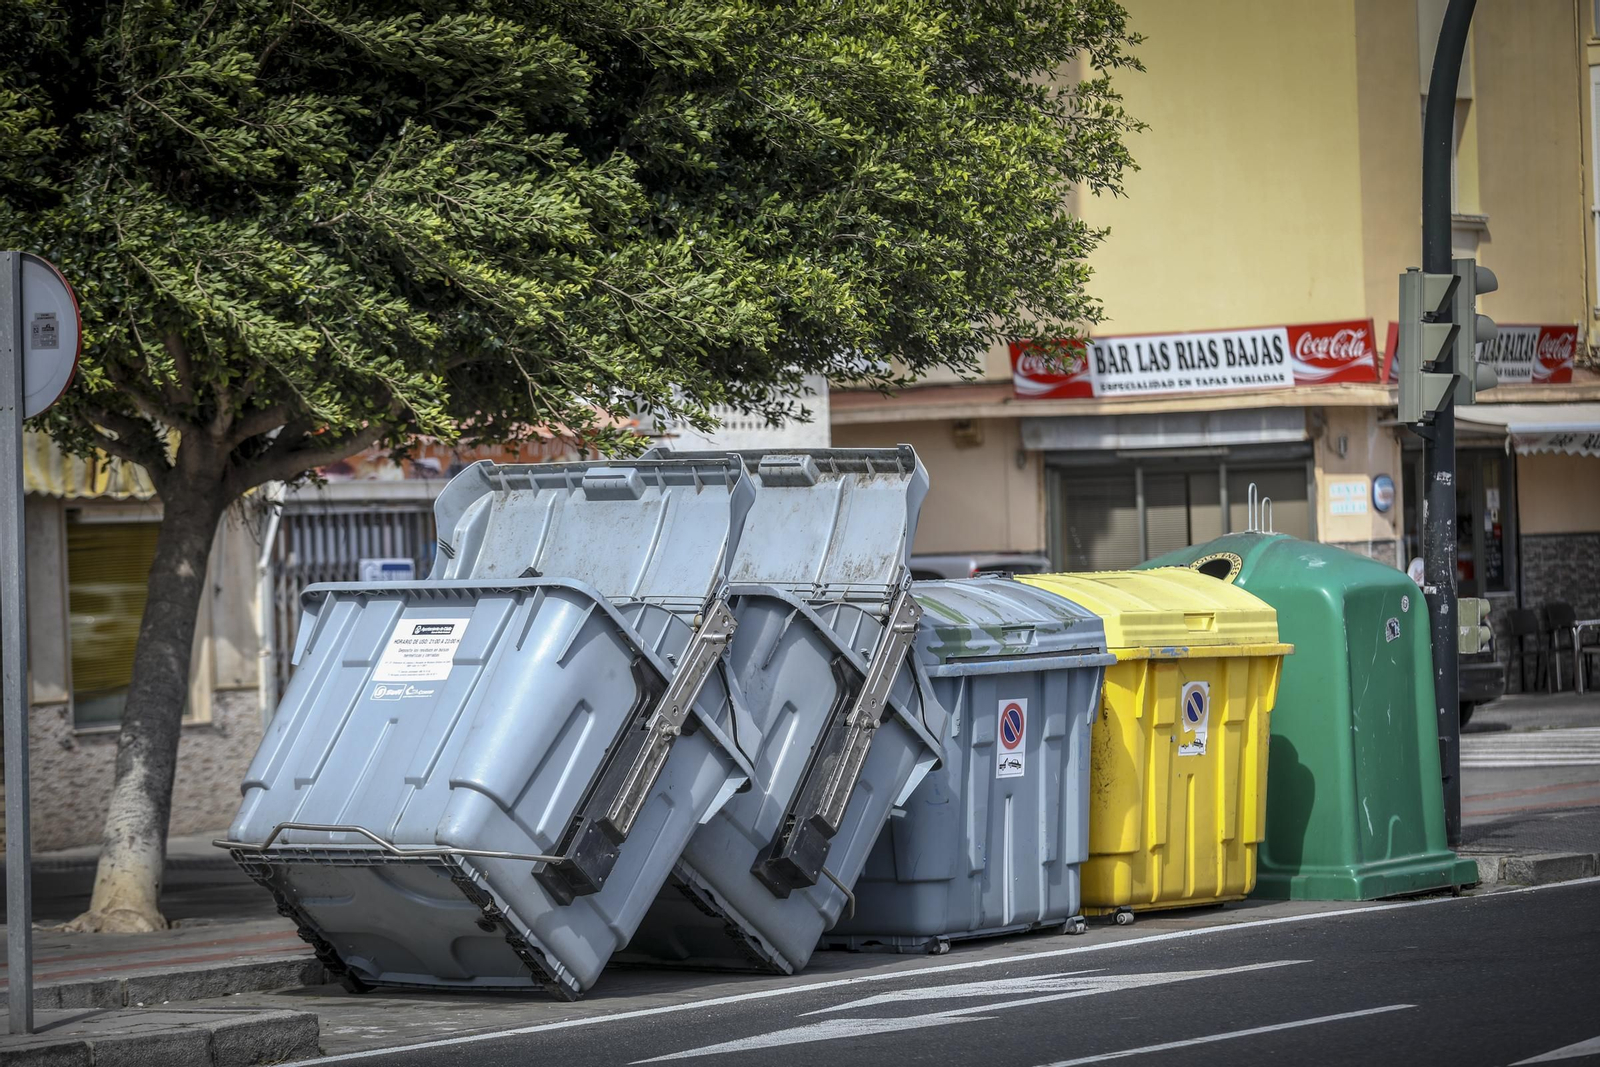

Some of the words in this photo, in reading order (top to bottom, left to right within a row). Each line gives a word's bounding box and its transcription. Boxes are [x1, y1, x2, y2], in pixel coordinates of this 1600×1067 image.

[1094, 342, 1133, 375] BAR
[1136, 340, 1171, 372] LAS
[1174, 338, 1220, 371] RIAS
[1223, 334, 1285, 368] BAJAS
[1100, 378, 1176, 392] ESPECIALIDAD
[1179, 377, 1193, 388] EN
[1195, 375, 1228, 387] TAPAS
[1231, 373, 1286, 385] VARIADAS
